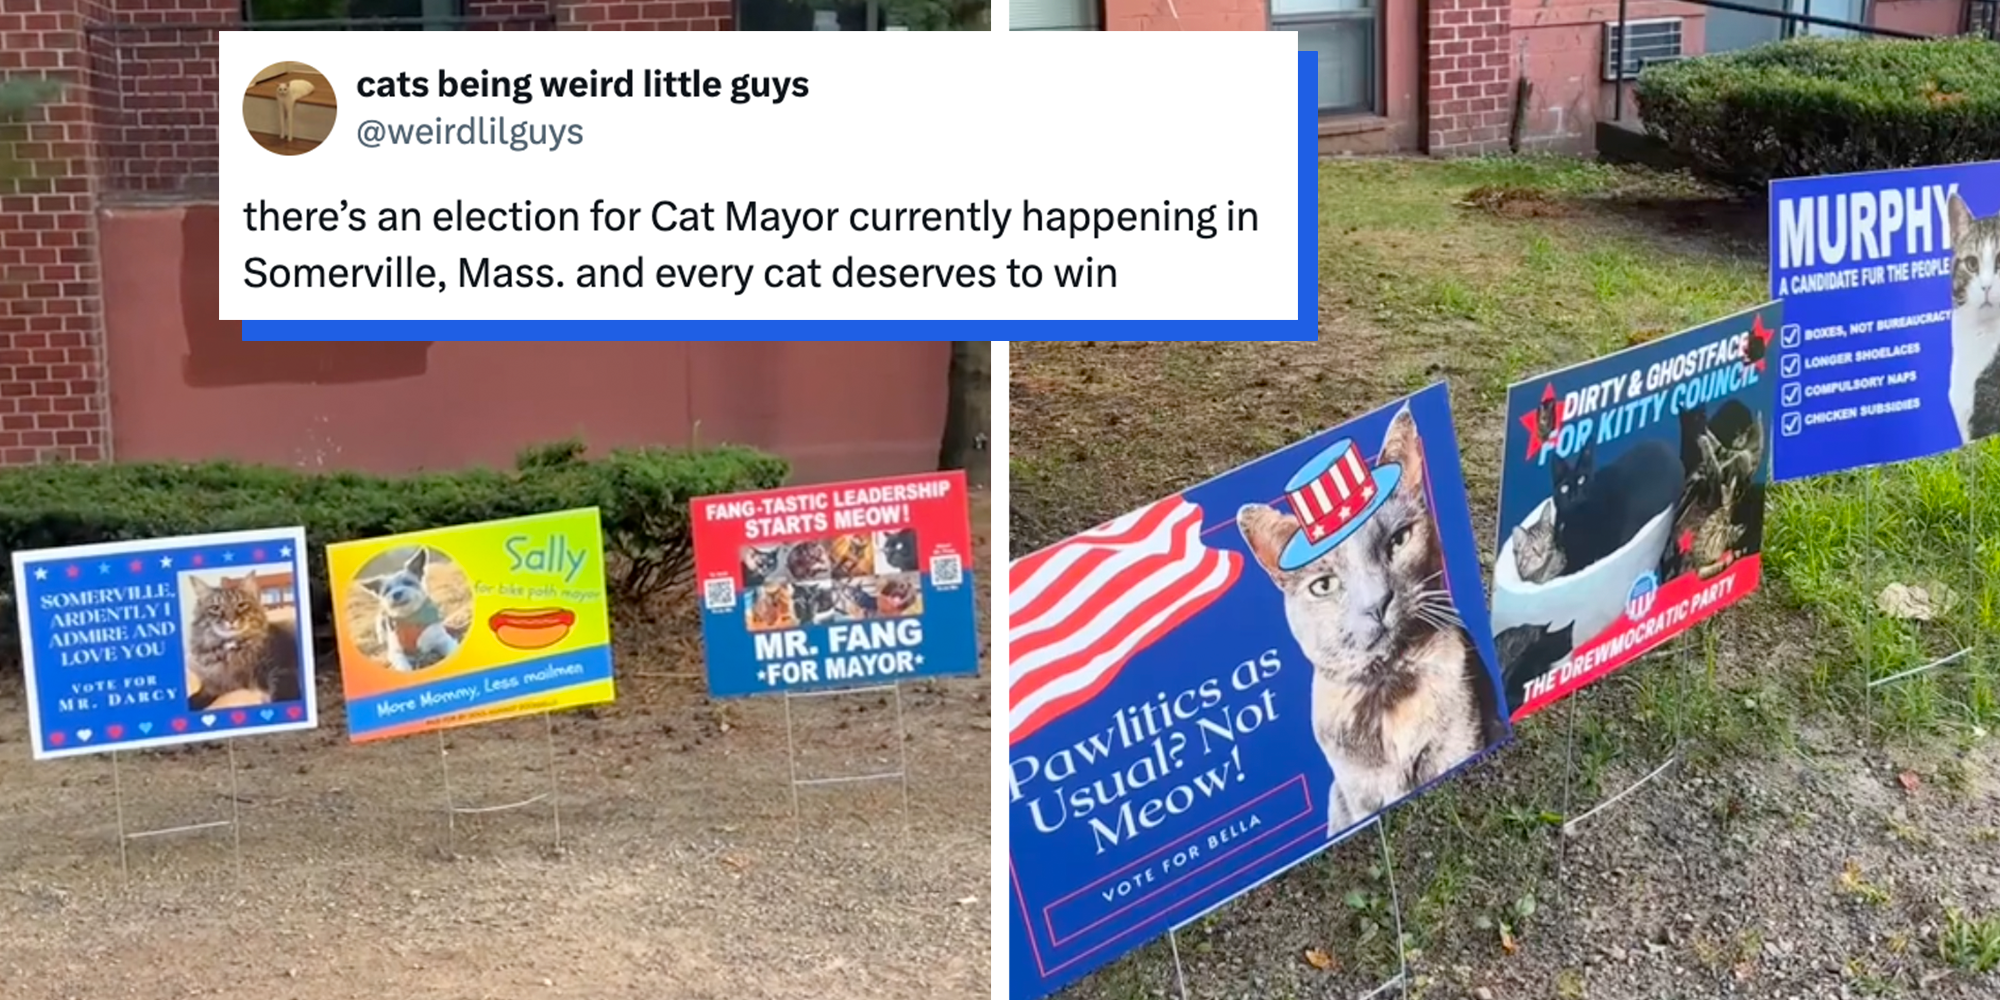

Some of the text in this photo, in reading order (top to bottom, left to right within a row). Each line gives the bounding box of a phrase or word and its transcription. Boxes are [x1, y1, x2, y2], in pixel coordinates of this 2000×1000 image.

[1779, 183, 1959, 269] MURPHY
[1779, 257, 1950, 296] A CANDIDATE FUR THE PEOPLE
[1850, 321, 1874, 335] NOT
[1804, 342, 1921, 369] LONGER SHOELACES
[1561, 332, 1750, 421] DIRTY & GHOSTFACE
[1804, 371, 1917, 397] COMPULSORY NAPS
[1538, 360, 1759, 466] FOR KITTY COUNCIL
[1804, 398, 1921, 425] CHICKEN SUBSIDIES
[705, 480, 951, 521] FANG-TASTIC LEADERSHIP
[745, 504, 910, 538] STARTS MEOW!
[505, 534, 586, 582] Sally
[474, 580, 601, 604] for bike path mayor
[48, 621, 176, 649] ADMIRE AND
[50, 602, 171, 630] ARDENTLY I
[61, 641, 166, 667] LOVE YOU
[755, 619, 923, 660] MR. FANG
[1523, 573, 1736, 703] THE DREWMOCRATIC PARTY
[124, 674, 157, 688] FOR
[825, 651, 914, 679] MAYOR
[108, 687, 177, 707] DARCY
[377, 700, 416, 718] More
[420, 685, 480, 707] Mommy,
[485, 676, 519, 693] Less
[524, 663, 584, 685] mailmen
[1009, 648, 1282, 803] Pawlitics as
[1027, 688, 1280, 833] Usual? Not
[1088, 745, 1246, 855] Meow!
[1102, 814, 1261, 902] VOTE FOR BELLA
